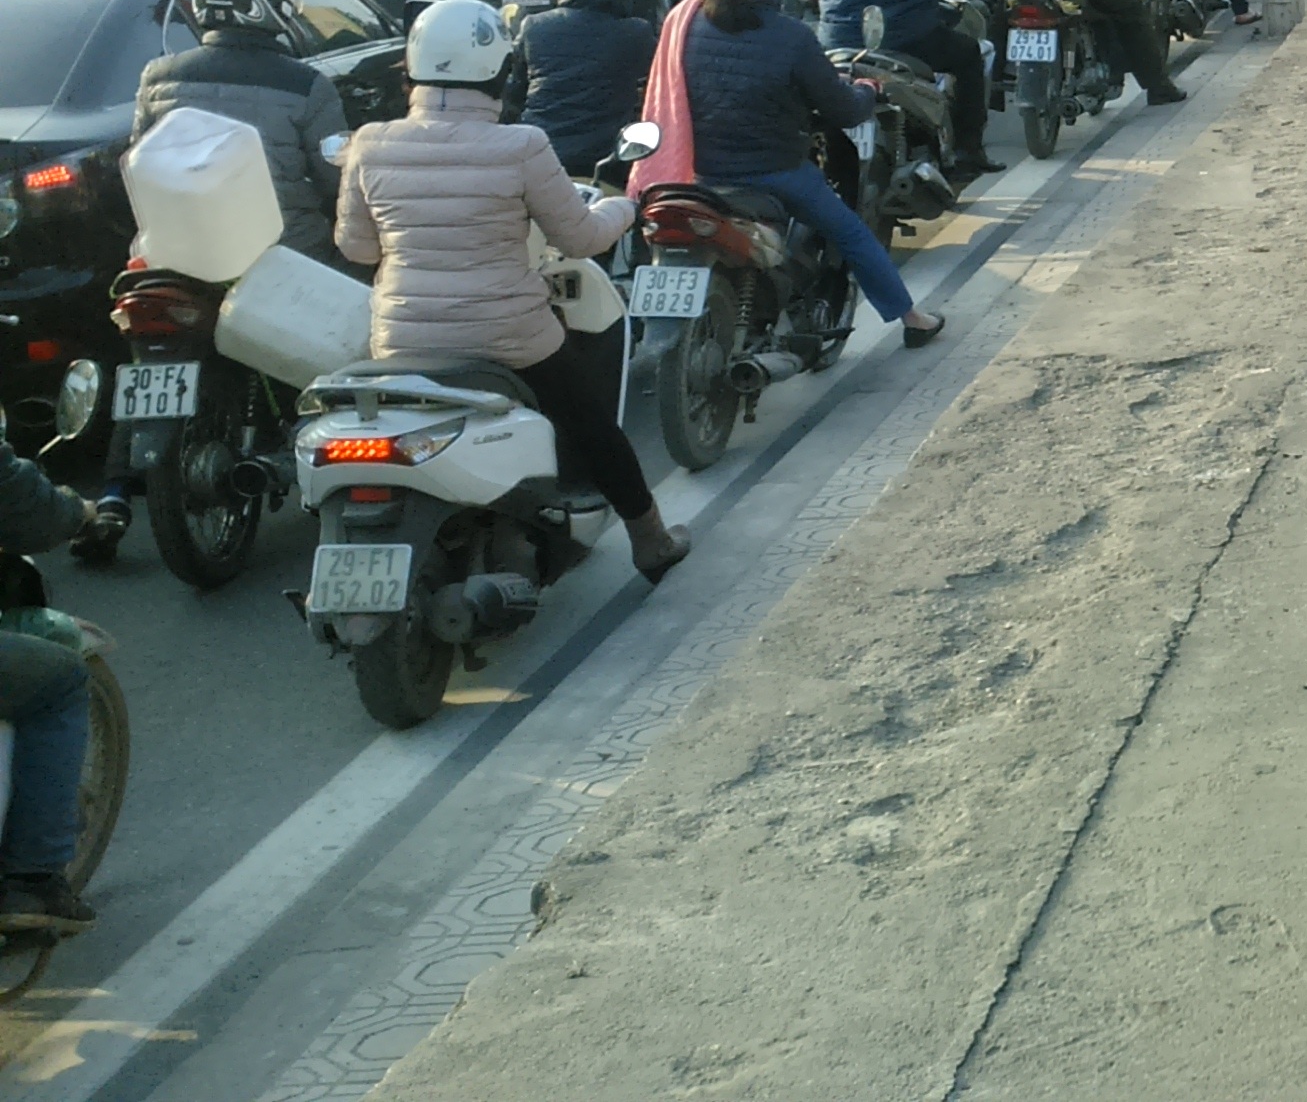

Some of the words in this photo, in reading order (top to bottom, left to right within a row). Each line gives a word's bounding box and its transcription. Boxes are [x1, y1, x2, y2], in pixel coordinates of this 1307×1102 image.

[1010, 45, 1052, 60] 074.01
[645, 270, 699, 291] 30-F3
[641, 292, 695, 313] 8829
[126, 364, 187, 391] 30-F4
[123, 392, 184, 416] 0101
[328, 548, 395, 577] 29-F1
[319, 579, 400, 608] 152.02
